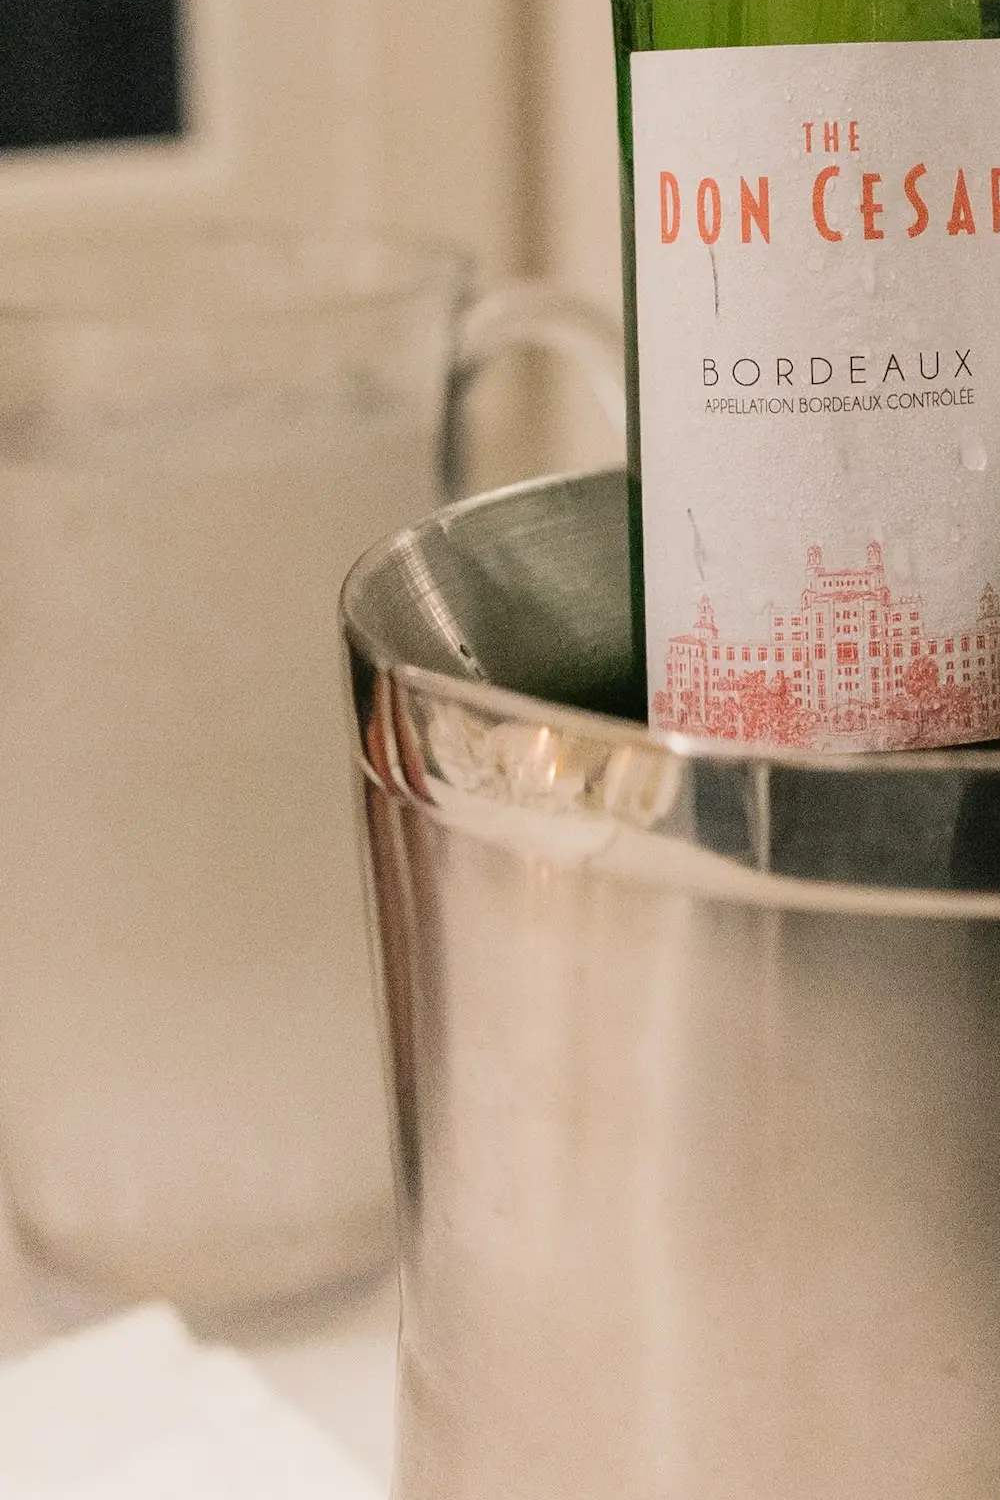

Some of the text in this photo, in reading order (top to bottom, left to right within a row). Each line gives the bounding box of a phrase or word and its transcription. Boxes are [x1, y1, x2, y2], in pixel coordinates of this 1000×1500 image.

[801, 120, 860, 153] THE
[659, 170, 771, 245] DON
[702, 348, 974, 388] BORDEAUX
[704, 386, 976, 415] APPELLATION BORDEAUX CONTRÔLÉE
